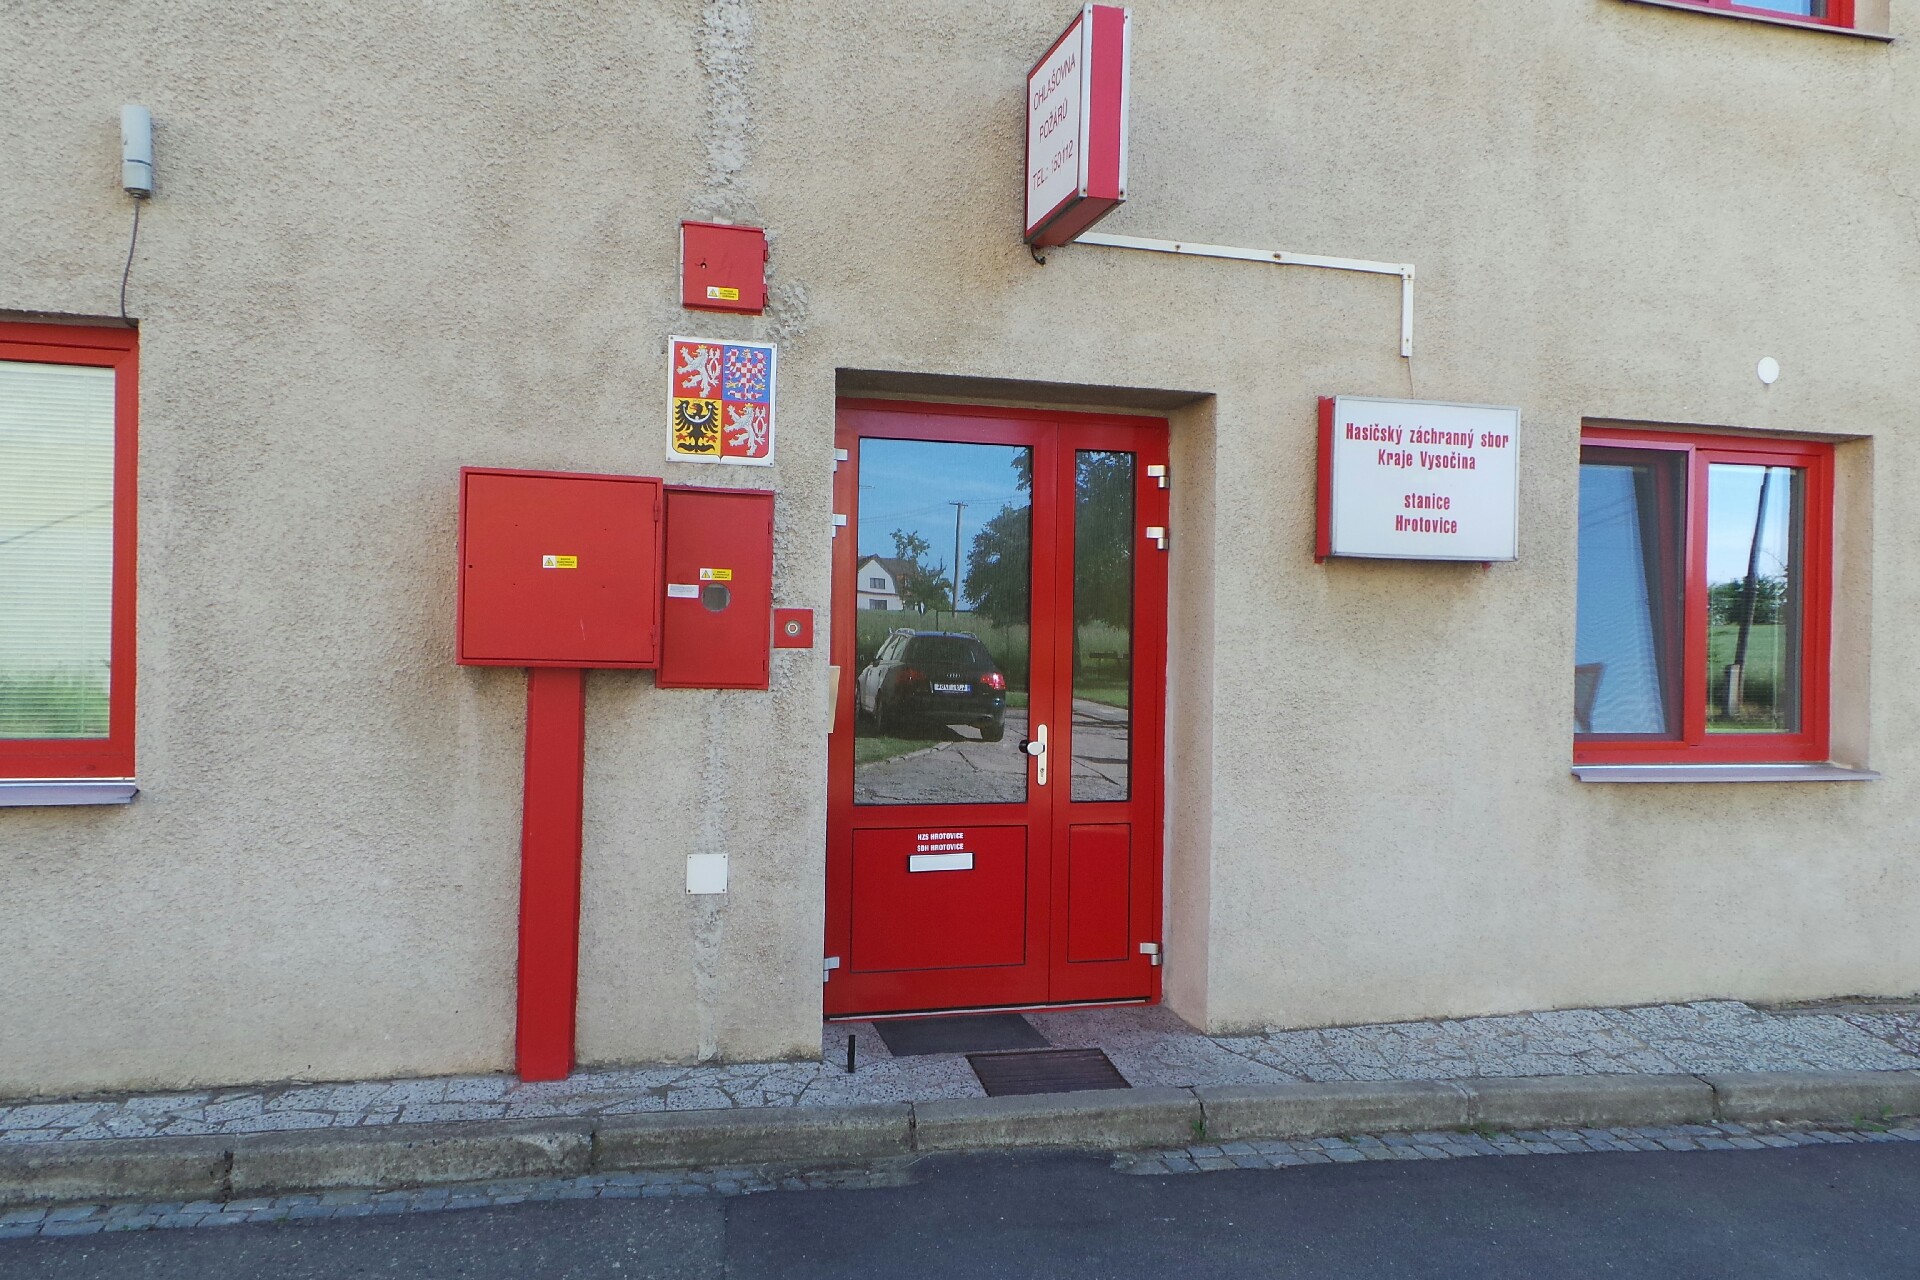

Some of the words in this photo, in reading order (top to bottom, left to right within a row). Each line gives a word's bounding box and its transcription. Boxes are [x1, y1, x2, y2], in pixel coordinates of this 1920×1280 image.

[1033, 53, 1076, 111] OHLAŠOVNA
[1039, 97, 1068, 143] POŽÁRŮ
[1345, 423, 1403, 446] Hasičský
[1409, 425, 1474, 449] záchranný
[1480, 431, 1509, 449] sbor
[1378, 449, 1413, 469] Kraje
[1420, 451, 1476, 471] Vysočina
[1404, 493, 1451, 510] stanice
[1395, 515, 1458, 534] Hrotovice
[917, 833, 929, 841] HZS
[930, 832, 964, 840] HROTOVICE
[930, 843, 964, 851] HROTOVICE
